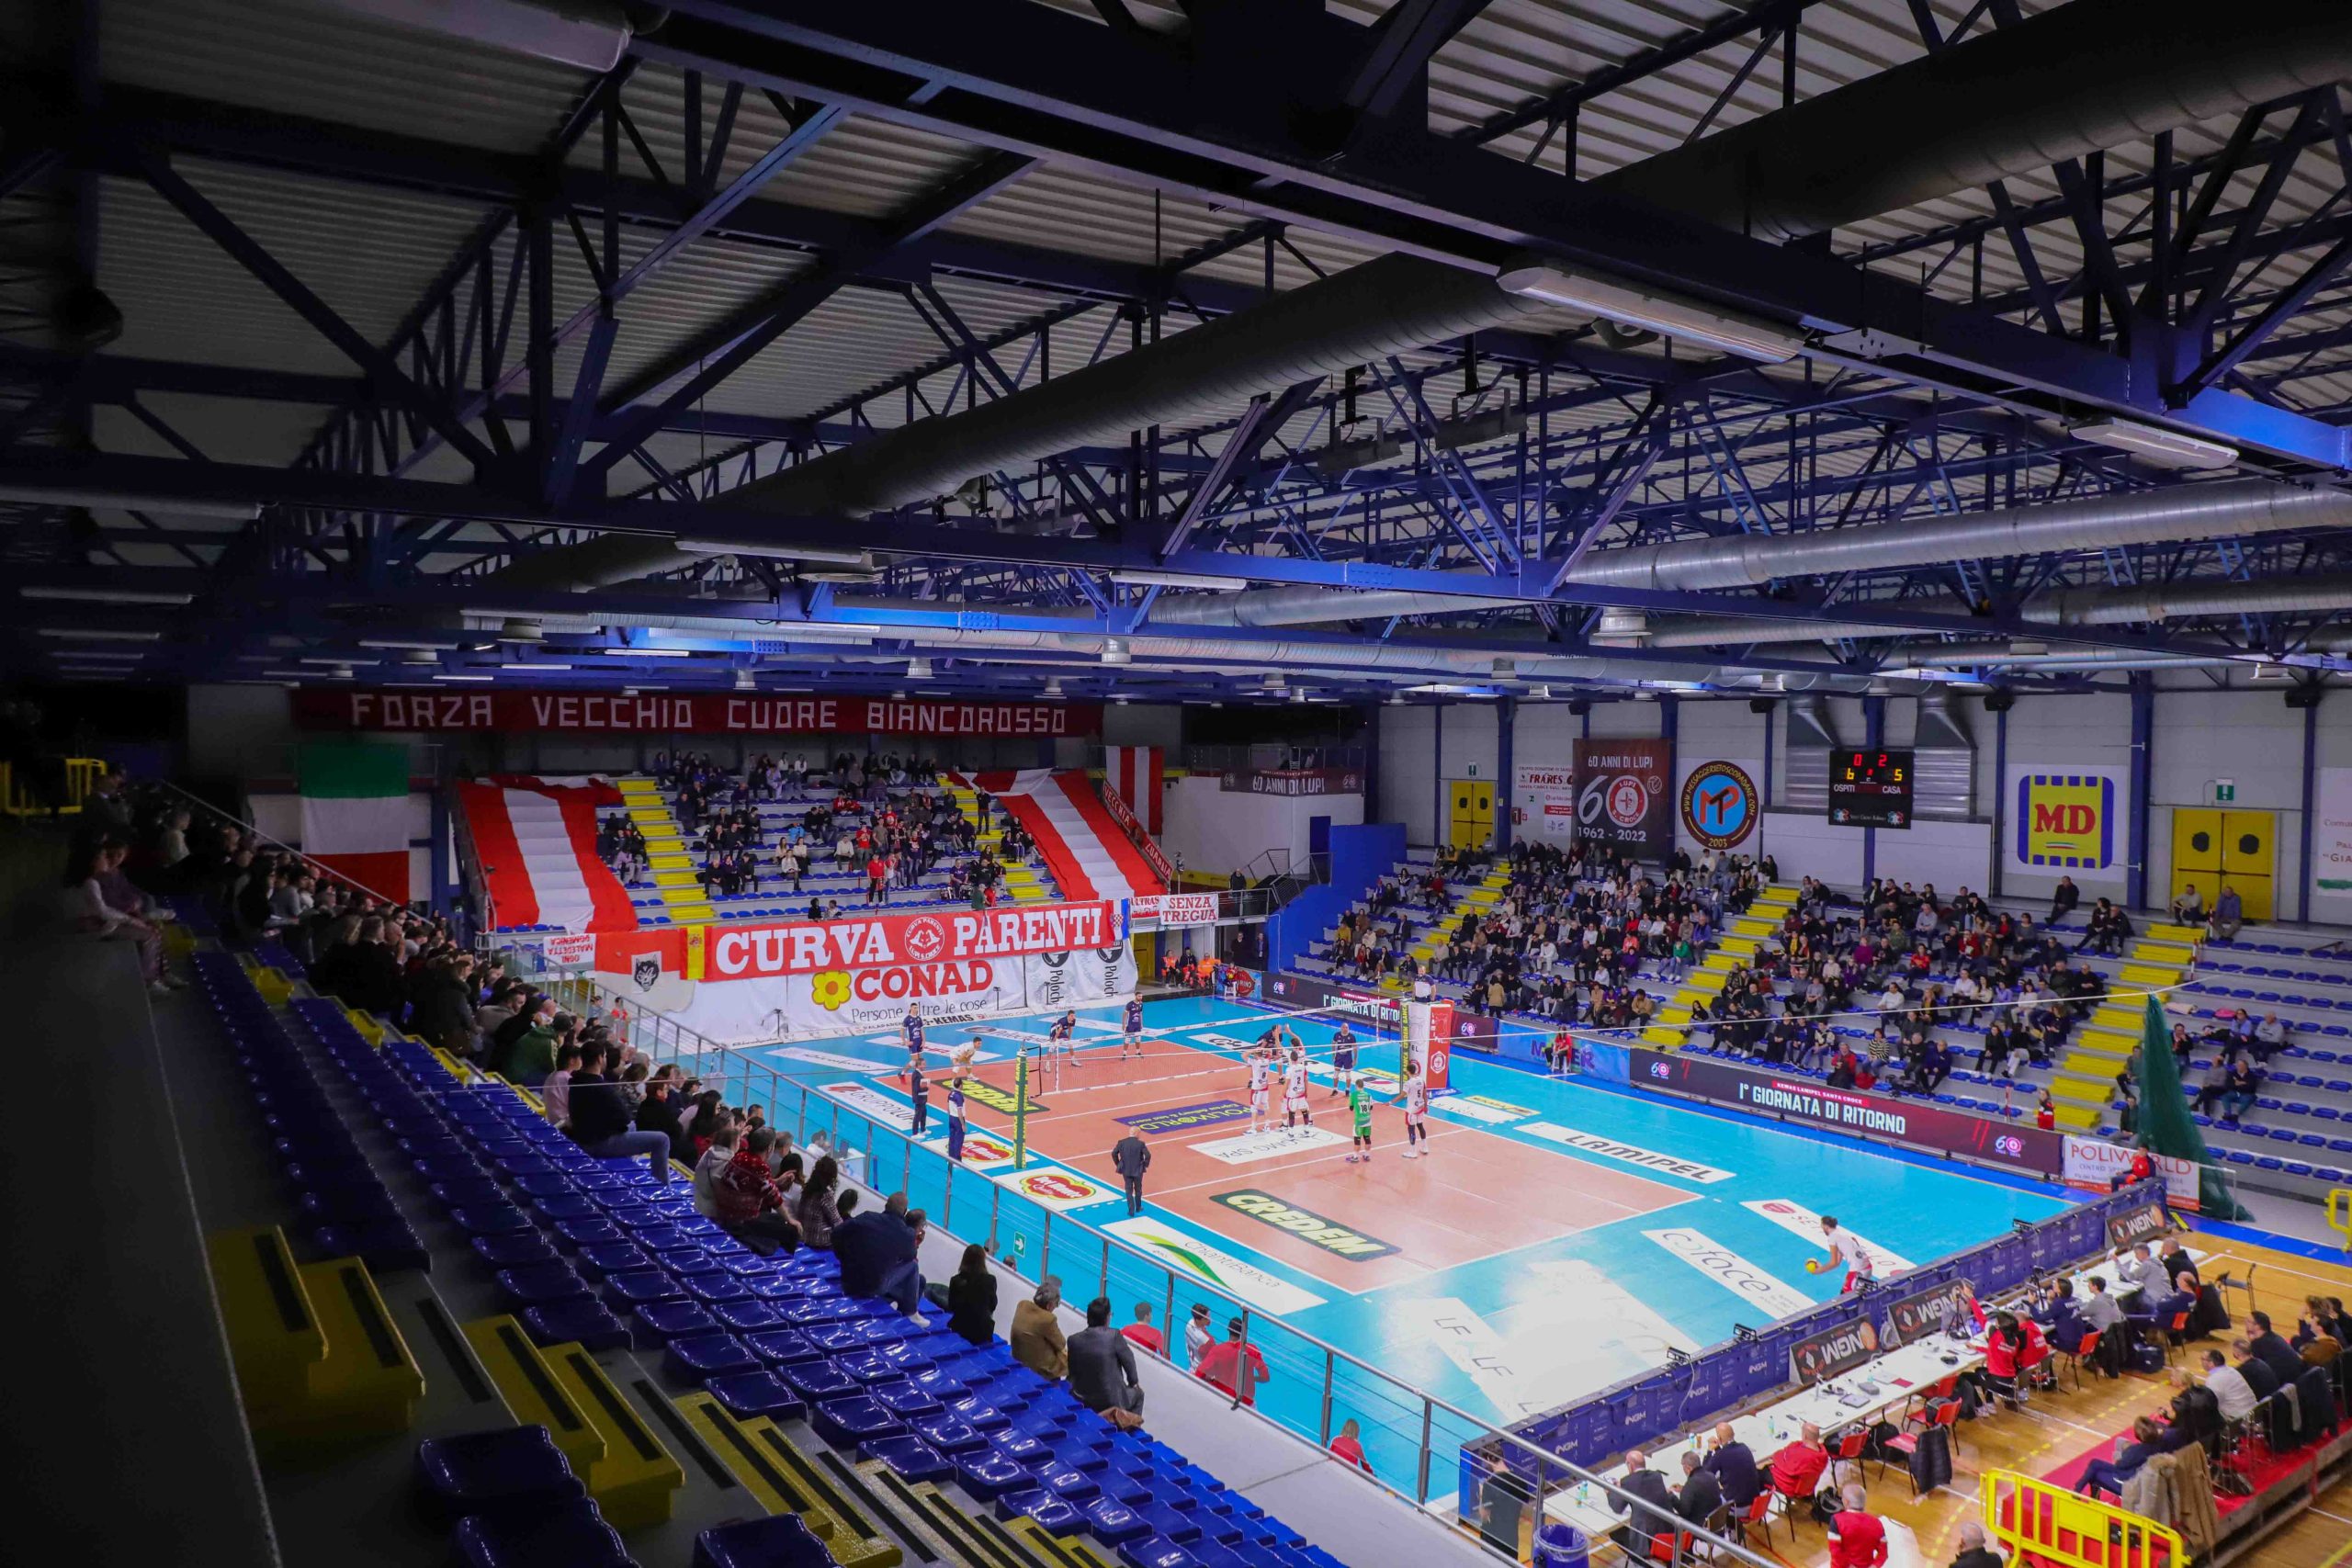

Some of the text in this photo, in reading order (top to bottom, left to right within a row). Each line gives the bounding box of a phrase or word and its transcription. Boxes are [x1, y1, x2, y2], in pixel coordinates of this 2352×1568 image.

[351, 694, 1066, 733] FORZA VECCHIO CUORE BIANCOROSSO
[1588, 755, 1653, 768] 60 ANNI DI LUPI
[1853, 753, 1887, 767] 0 2
[1265, 777, 1286, 794] ANNI
[1288, 779, 1299, 795] DI
[1303, 777, 1325, 793] LUPI
[1846, 768, 1903, 781] 6 5
[1834, 784, 1855, 793] OSPITI
[1883, 785, 1901, 794] CASA
[1103, 785, 1130, 826] VECCHIA
[2034, 803, 2096, 835] MD
[1577, 827, 1604, 839] 1962
[1617, 829, 1646, 841] 2022
[1163, 909, 1217, 921] TREGUA
[1169, 897, 1212, 909] SENZA
[716, 908, 1102, 974] CURVA PARENTI
[854, 960, 992, 1001] CONAD
[1050, 970, 1065, 1003] Poloch
[1104, 965, 1119, 998] Poloch
[852, 999, 987, 1023] Persone ltre le cose
[933, 1014, 975, 1024] KEMAS
[1823, 1091, 1842, 1100] SANTA
[1843, 1095, 1862, 1104] CROCE
[1752, 1089, 1820, 1117] GIORNATA
[1826, 1101, 1838, 1119] DI
[1843, 1104, 1905, 1134] RITORNO
[1566, 1135, 1714, 1179] LAMIPEL
[2071, 1144, 2191, 1175] POLIWRLD
[1227, 1195, 1385, 1255] CREDEM
[2126, 1212, 2156, 1235] NGM
[1821, 1330, 1865, 1365] NGM
